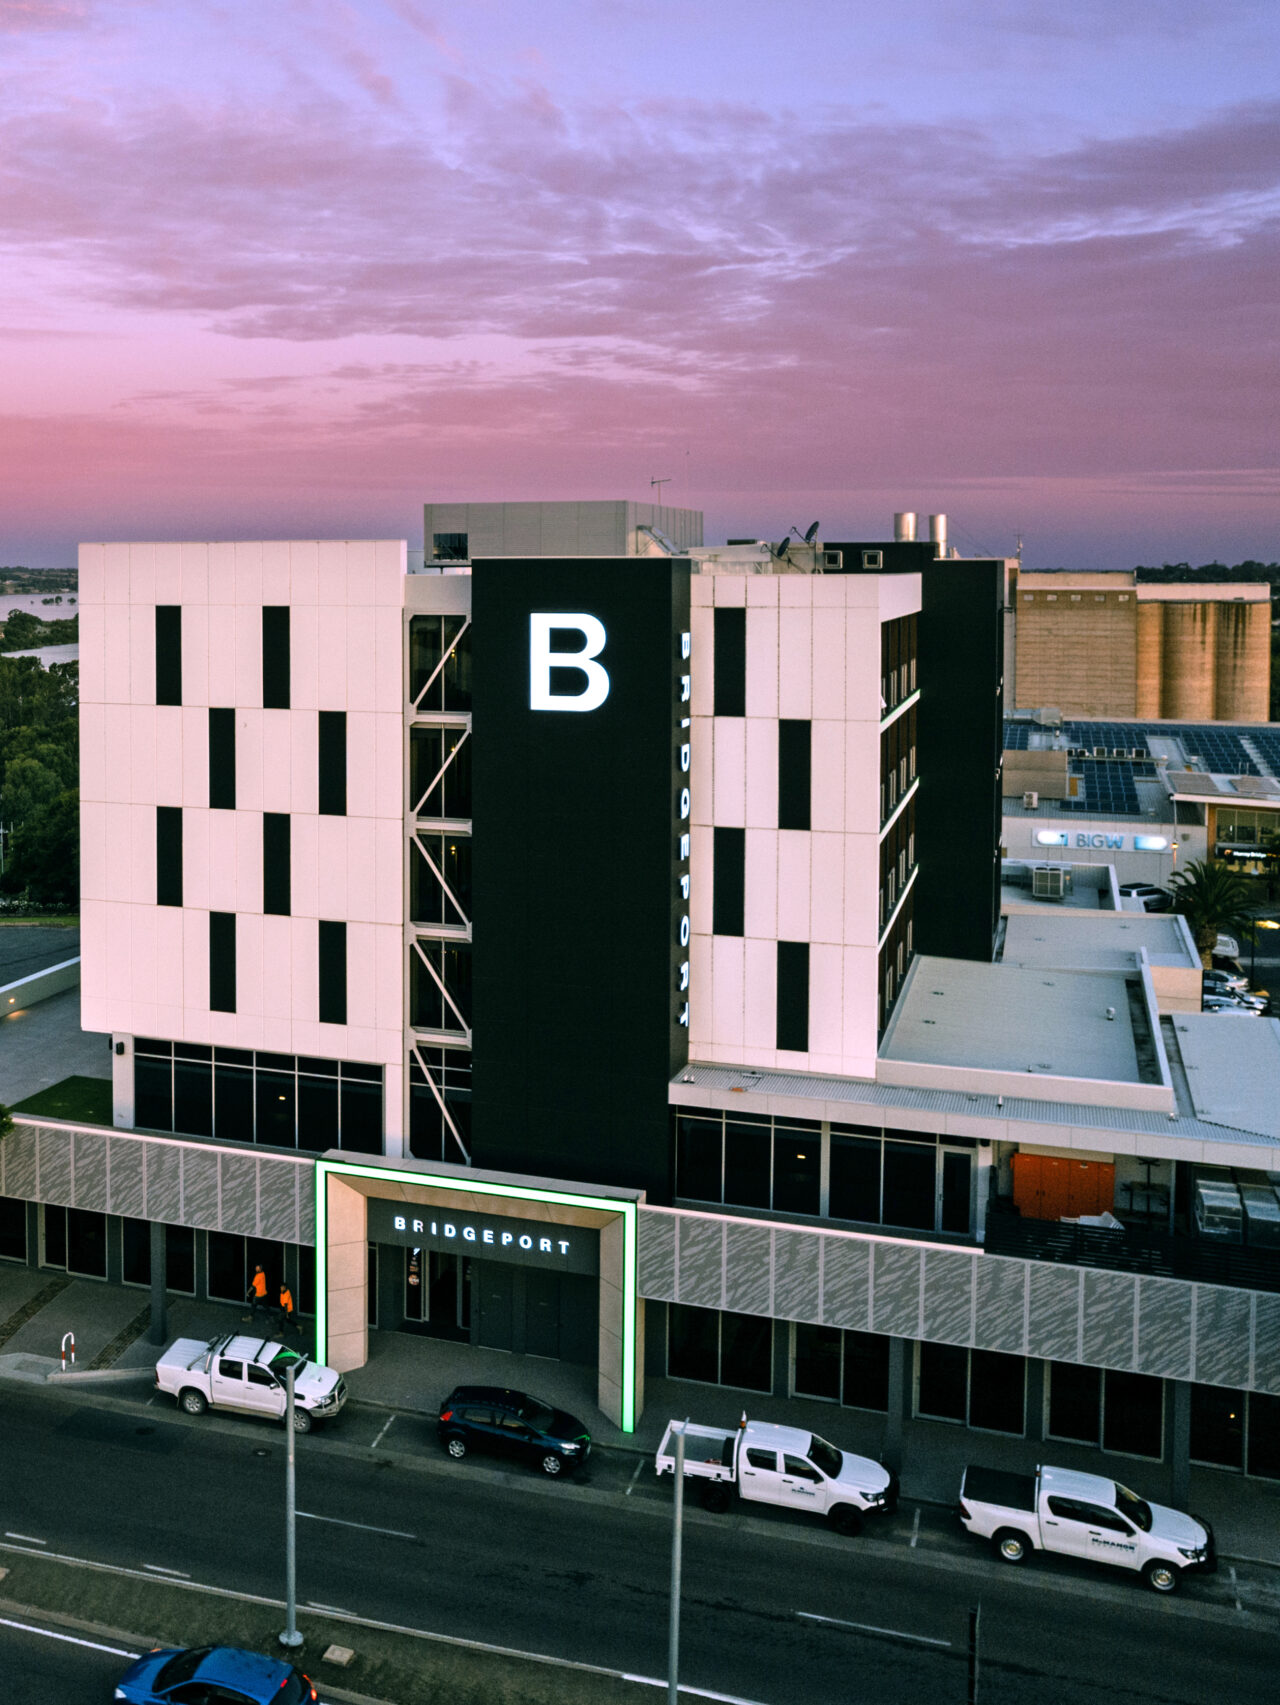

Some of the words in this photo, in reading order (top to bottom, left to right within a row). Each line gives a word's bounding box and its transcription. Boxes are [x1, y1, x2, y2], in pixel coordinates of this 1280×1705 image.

[530, 613, 610, 711] B
[679, 632, 690, 1028] BRIDGEPORT
[394, 1216, 570, 1254] BRIDGEPORT
